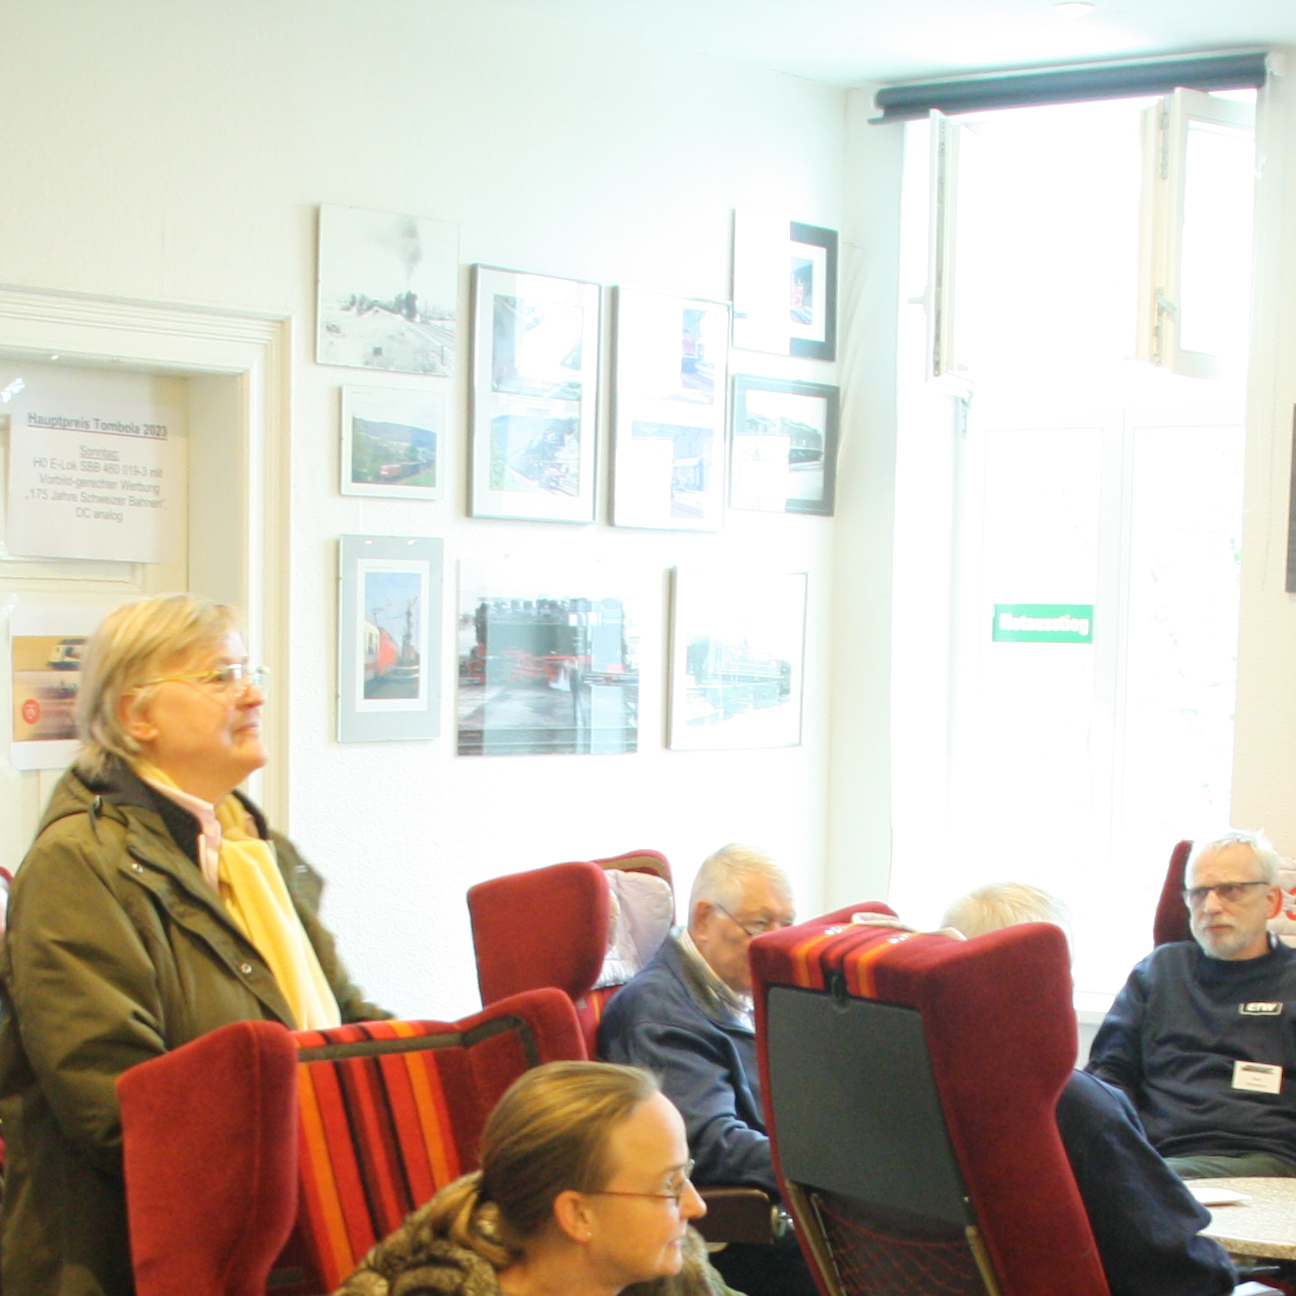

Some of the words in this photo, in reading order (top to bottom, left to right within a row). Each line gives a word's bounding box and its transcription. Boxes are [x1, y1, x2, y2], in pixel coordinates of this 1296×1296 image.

[27, 411, 90, 430] Hauptpreis
[94, 418, 140, 434] Tombola
[143, 424, 168, 437] 2023
[50, 458, 77, 471] E-Lok
[80, 461, 101, 473] SBB
[103, 463, 120, 475] 460
[39, 473, 118, 490] Vorbild-gerechter
[121, 480, 161, 496] Werbung
[50, 490, 78, 503] Jahre
[80, 492, 126, 506] Schweizer
[75, 507, 91, 519] DC
[93, 510, 124, 523] analog
[998, 612, 1090, 636] Notausstieg
